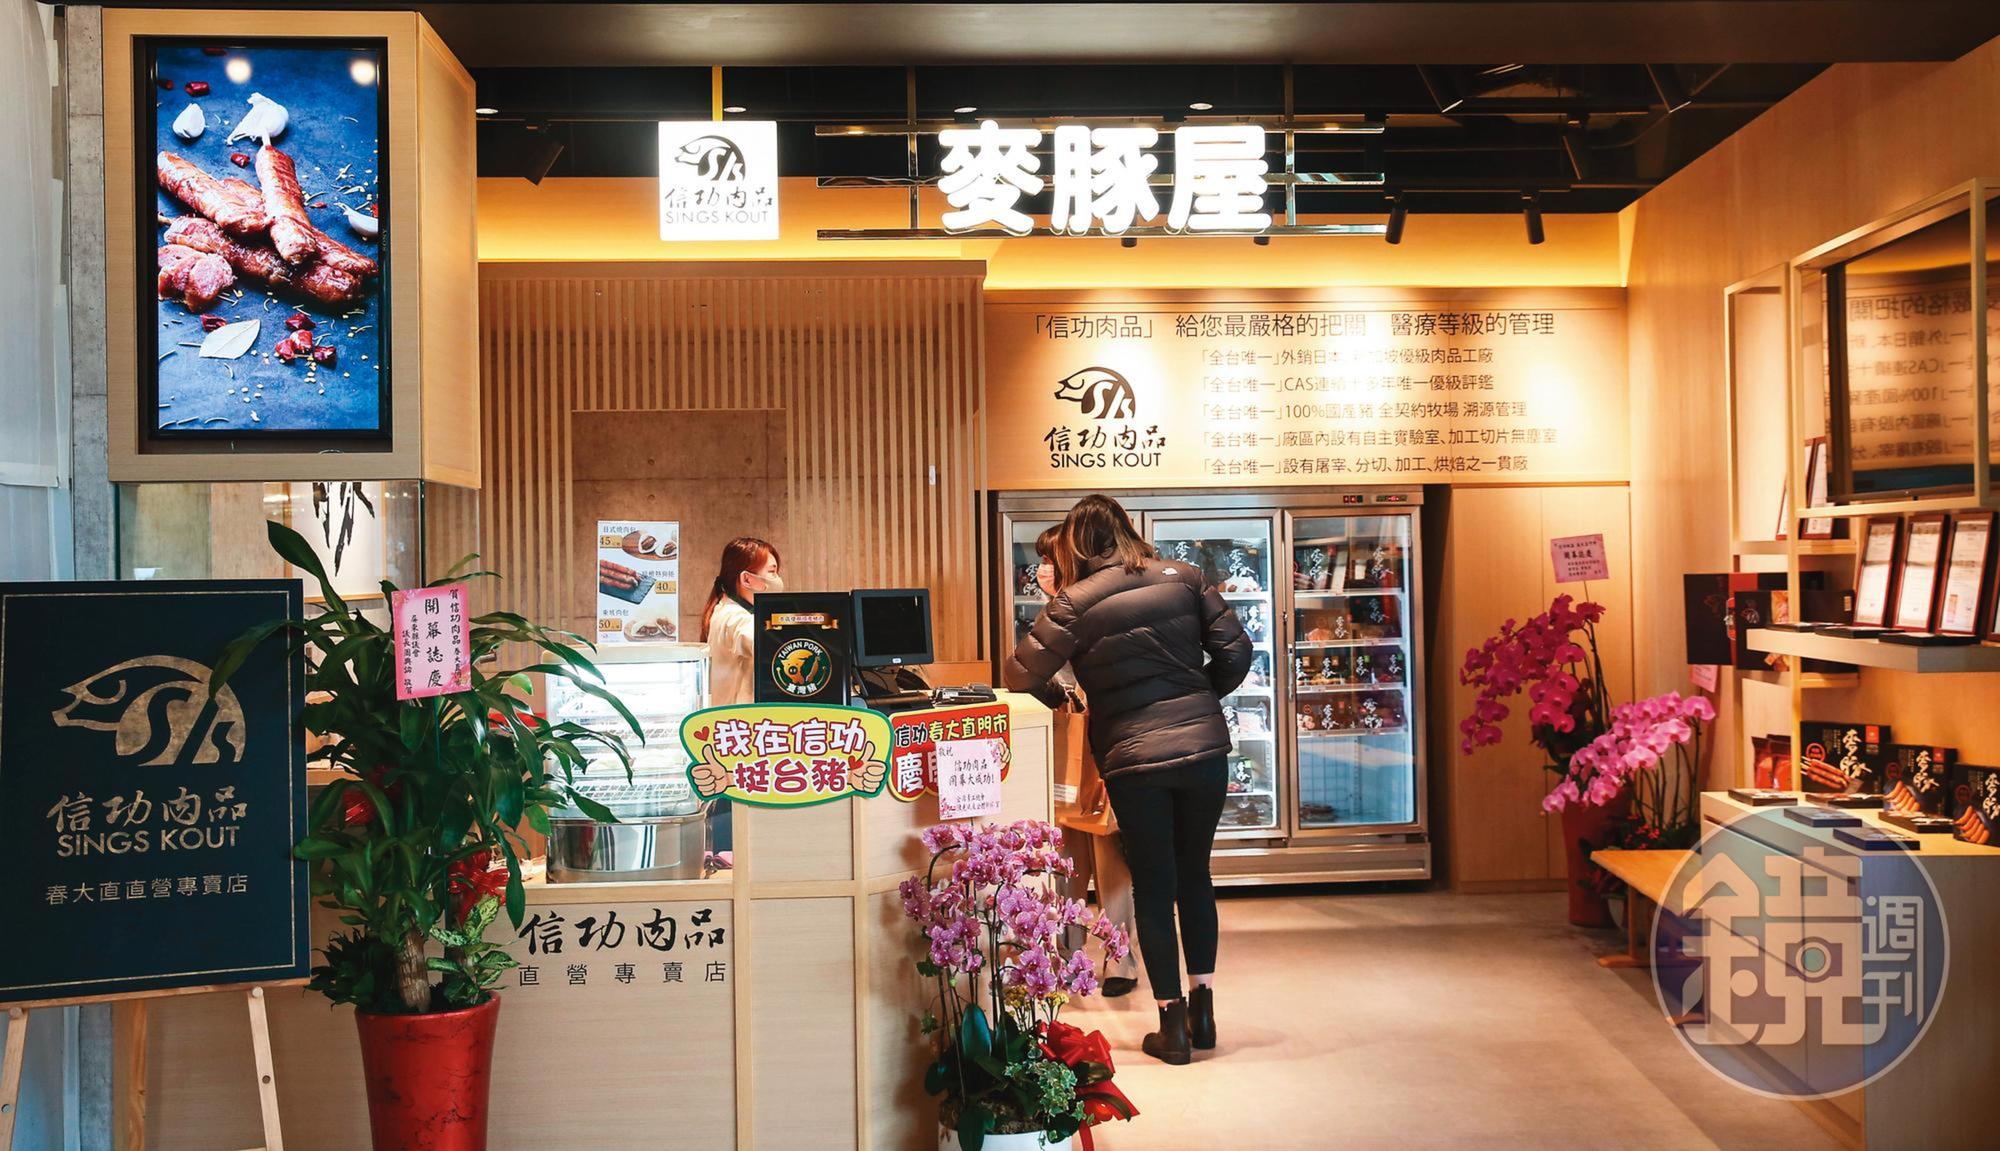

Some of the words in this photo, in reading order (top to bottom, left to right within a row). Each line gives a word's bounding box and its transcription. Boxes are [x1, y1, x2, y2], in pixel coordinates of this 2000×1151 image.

[937, 119, 1273, 235] 麥豚屋
[665, 186, 773, 208] 信功肉品
[665, 211, 720, 223] SINGS
[725, 211, 769, 223] KOUT
[1034, 314, 1153, 340] 「信功肉品」
[1176, 313, 1366, 338] 給您最嚴格的把關
[1391, 312, 1555, 337] 醫療等級的管理
[1043, 425, 1166, 452] 信功肉品
[1050, 453, 1106, 468] SINGS
[1113, 453, 1161, 467] KOUT
[778, 641, 803, 660] TAIWAN
[803, 641, 823, 656] PORK
[713, 717, 867, 757] 我在信功
[735, 758, 848, 794] 挺台豬
[47, 785, 248, 833] 信功肉品
[57, 830, 150, 857] SINGS
[160, 826, 240, 851] KOUT
[46, 873, 248, 905] 春大直直營專賣店
[518, 908, 725, 955] 信功肉品
[518, 960, 727, 987] 直營專賣店
